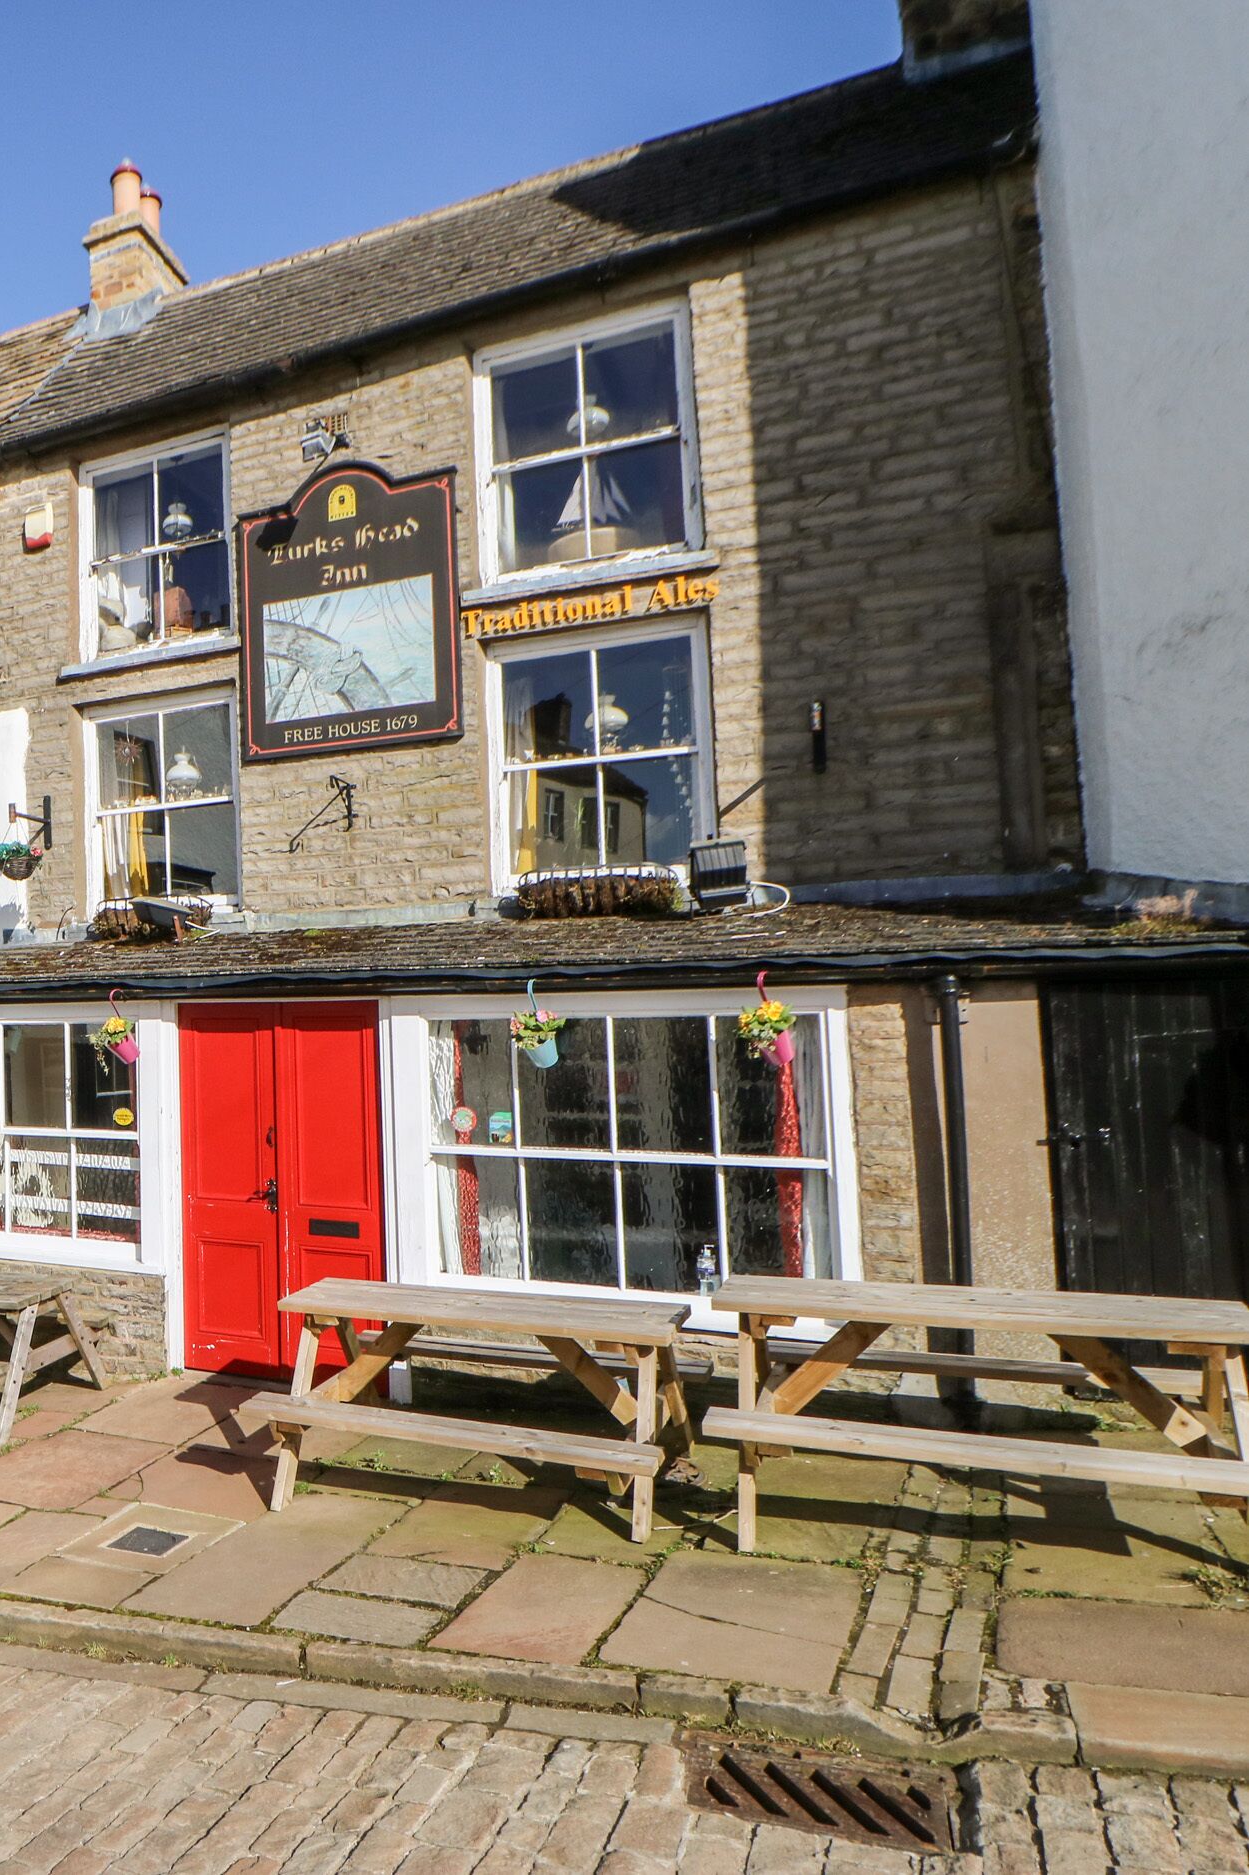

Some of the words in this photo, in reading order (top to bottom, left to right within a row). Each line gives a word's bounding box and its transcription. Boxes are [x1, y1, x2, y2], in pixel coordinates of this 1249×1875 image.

[267, 535, 345, 567] Turks
[355, 517, 420, 549] Head
[319, 562, 368, 587] Inn
[461, 584, 633, 636] Traditional
[649, 574, 720, 609] Ales
[283, 726, 323, 744] FREE
[328, 719, 381, 738] HOUSE
[385, 714, 418, 731] 1679
